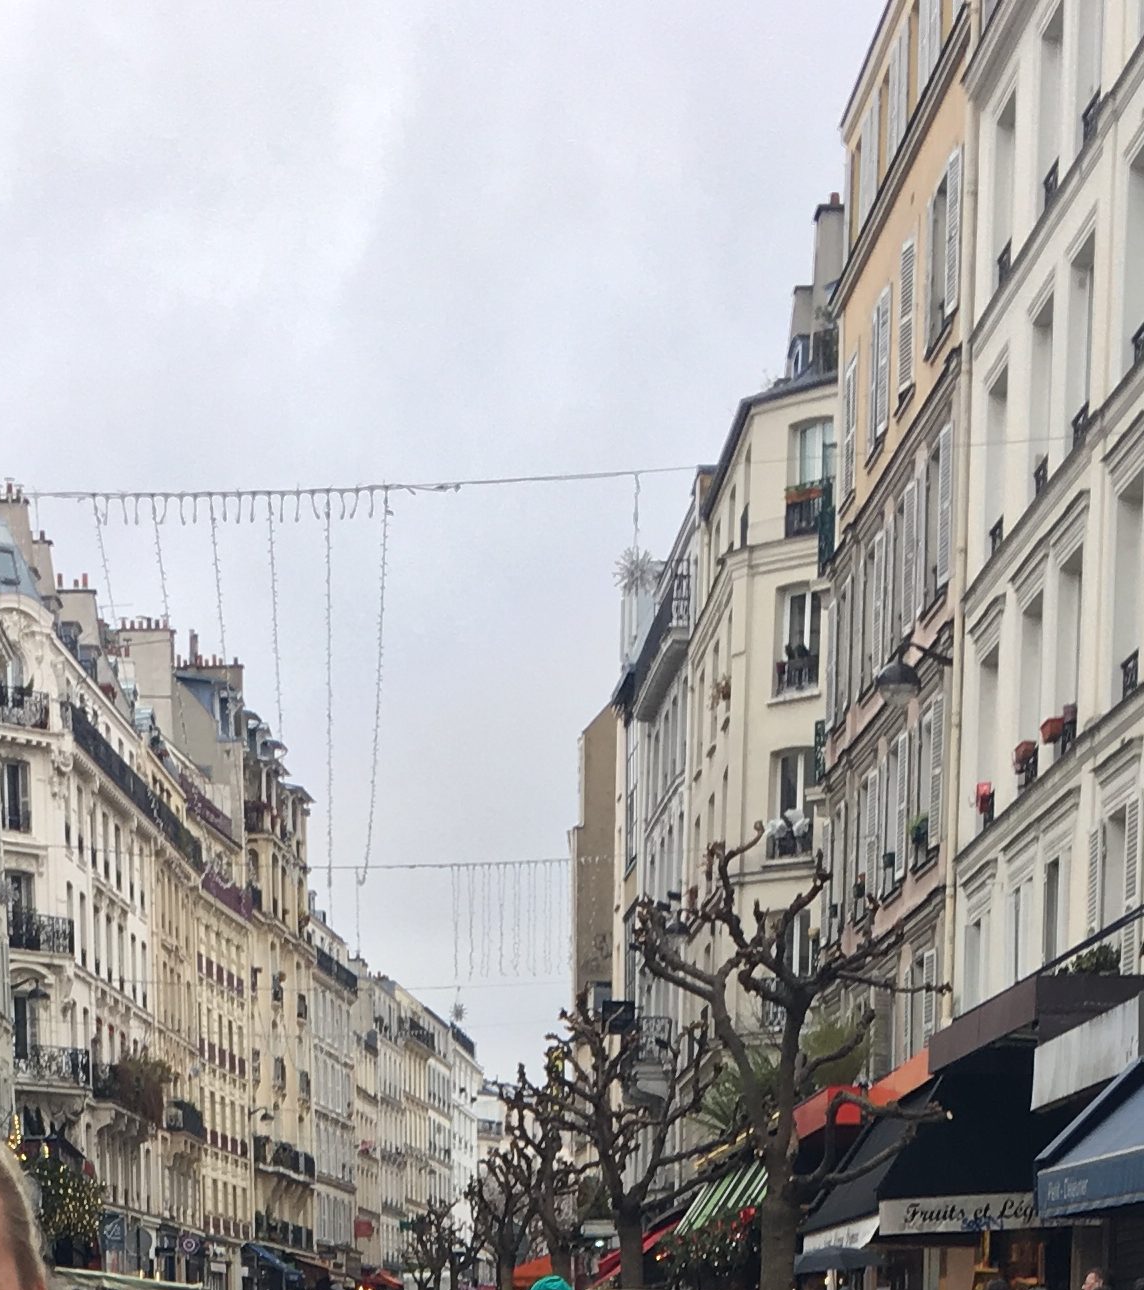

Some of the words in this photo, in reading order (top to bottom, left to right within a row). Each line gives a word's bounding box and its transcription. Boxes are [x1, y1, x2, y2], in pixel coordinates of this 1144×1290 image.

[904, 1202, 966, 1224] Fruits
[973, 1203, 991, 1221] et
[998, 1199, 1039, 1224] Lég
